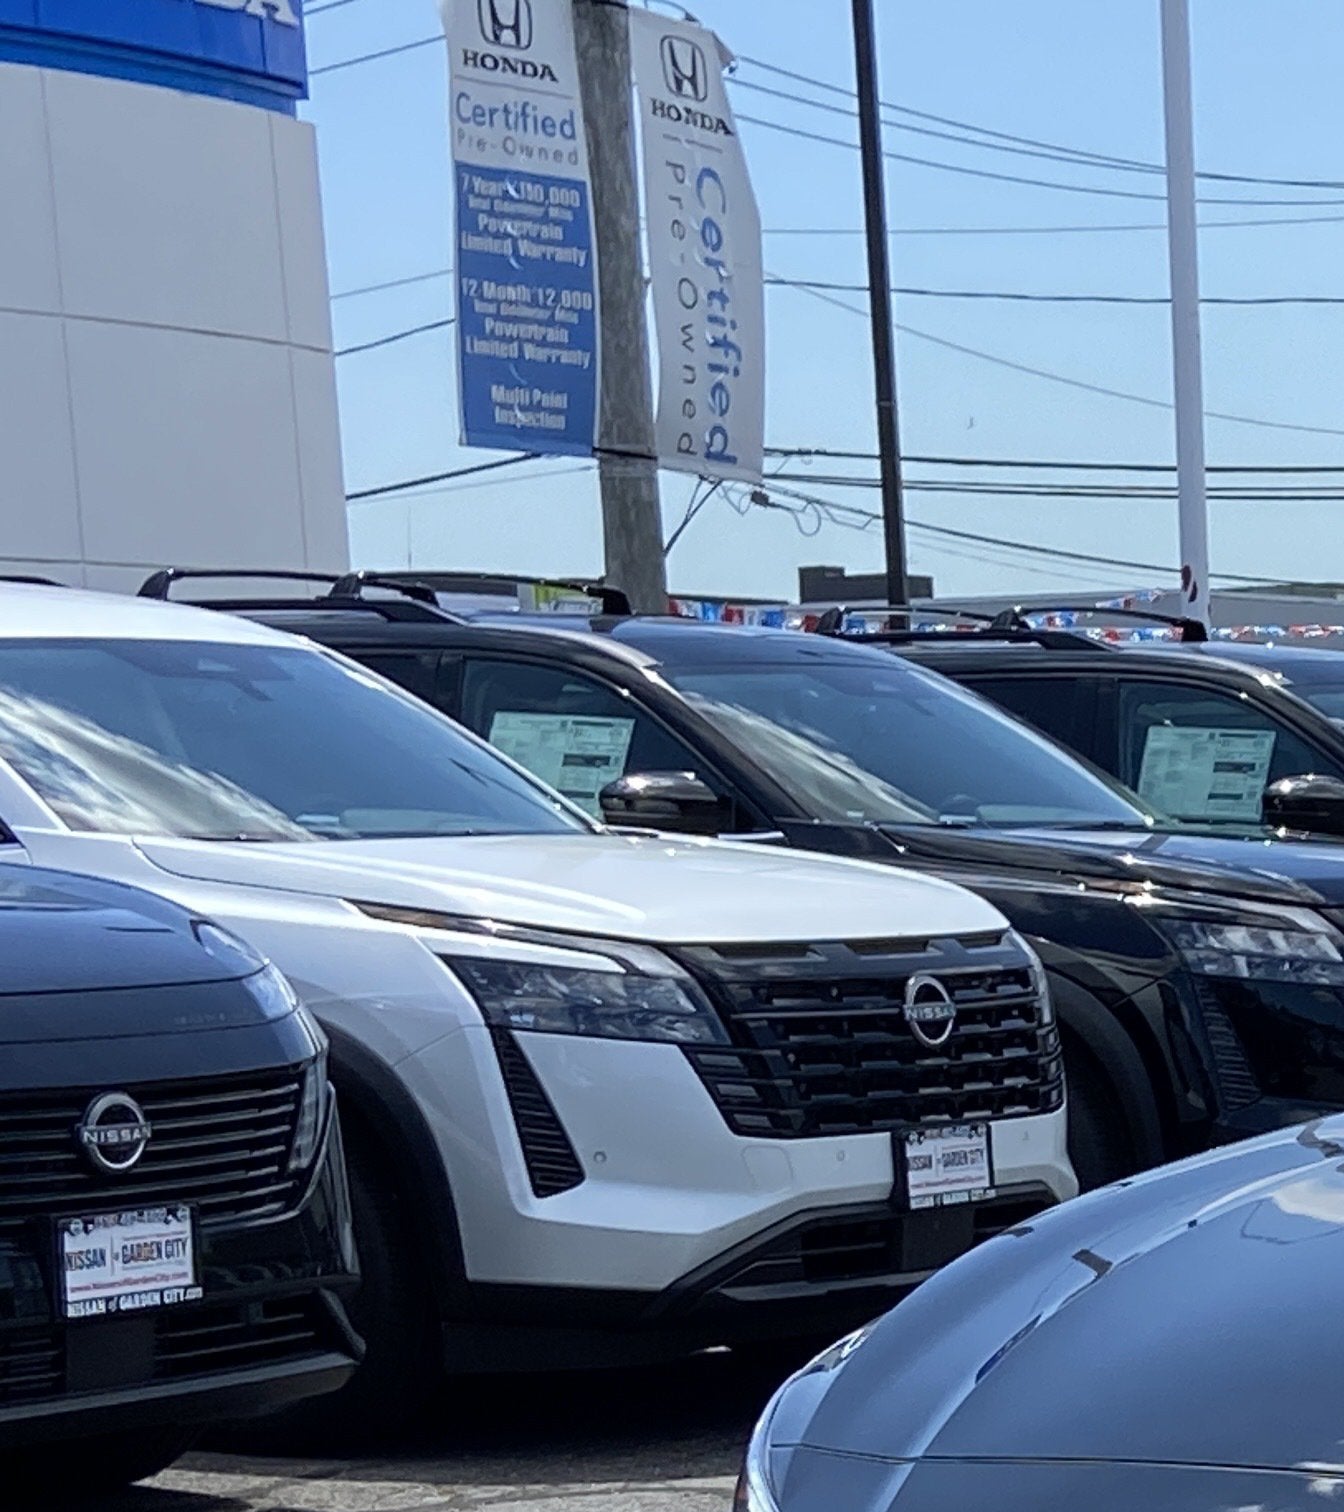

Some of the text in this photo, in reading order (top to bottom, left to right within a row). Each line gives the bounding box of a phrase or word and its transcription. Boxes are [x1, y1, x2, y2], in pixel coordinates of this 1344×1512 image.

[463, 49, 559, 83] HONDA
[456, 92, 577, 140] Certified
[650, 98, 734, 136] HONDA
[457, 127, 578, 166] Pre-Owned
[461, 277, 478, 297] 12
[665, 160, 698, 455] Pre-Owned
[696, 167, 742, 465] Certified
[83, 1126, 151, 1144] NISSAN
[65, 1247, 106, 1272] NISSAN
[121, 1241, 163, 1265] GARDEN
[164, 1237, 189, 1260] CITY
